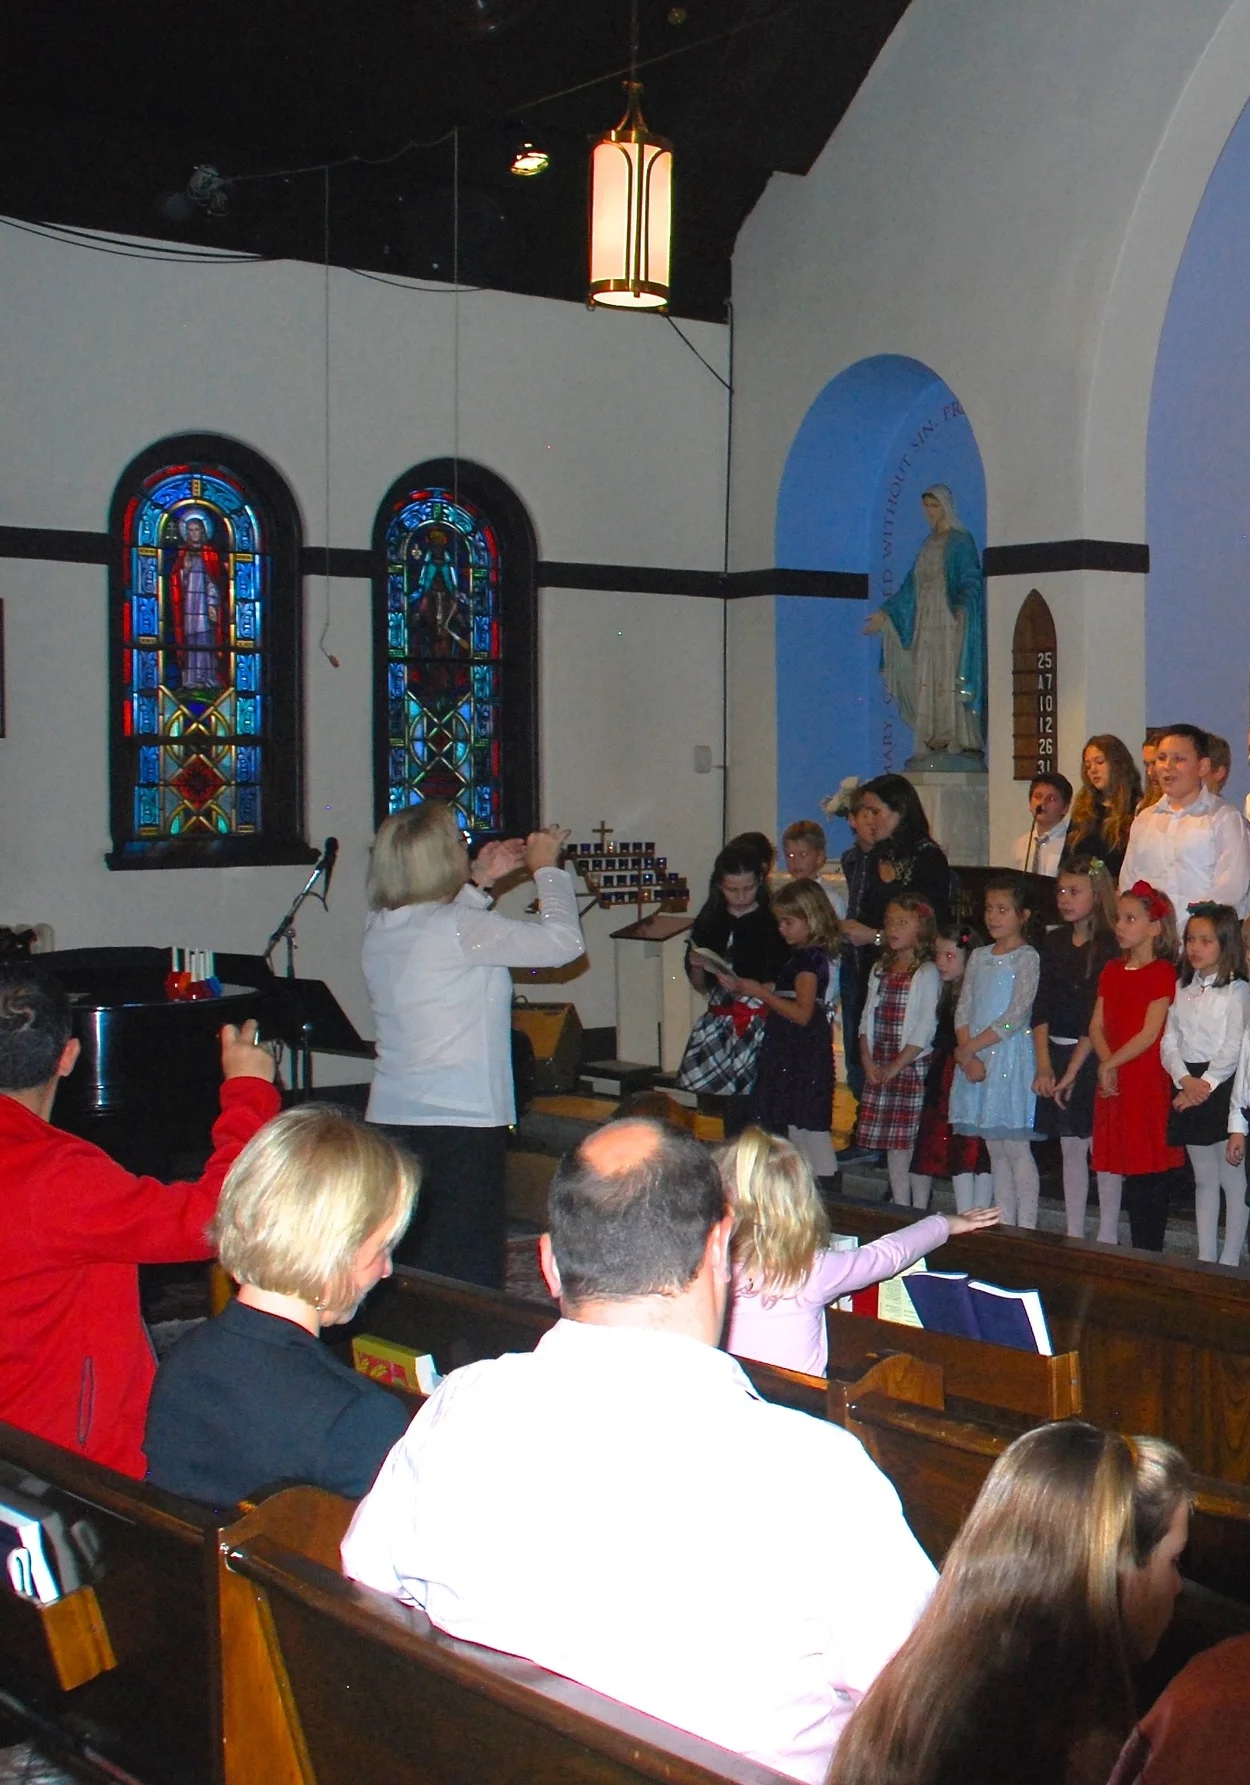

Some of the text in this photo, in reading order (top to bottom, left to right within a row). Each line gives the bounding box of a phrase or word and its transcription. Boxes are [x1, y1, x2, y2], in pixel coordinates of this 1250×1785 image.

[882, 453, 912, 559] WITHOUT
[1037, 651, 1052, 669] 25
[1039, 695, 1053, 713] 10
[1039, 716, 1053, 733] 12
[1038, 738, 1053, 755] 26
[1037, 759, 1051, 775] 31
